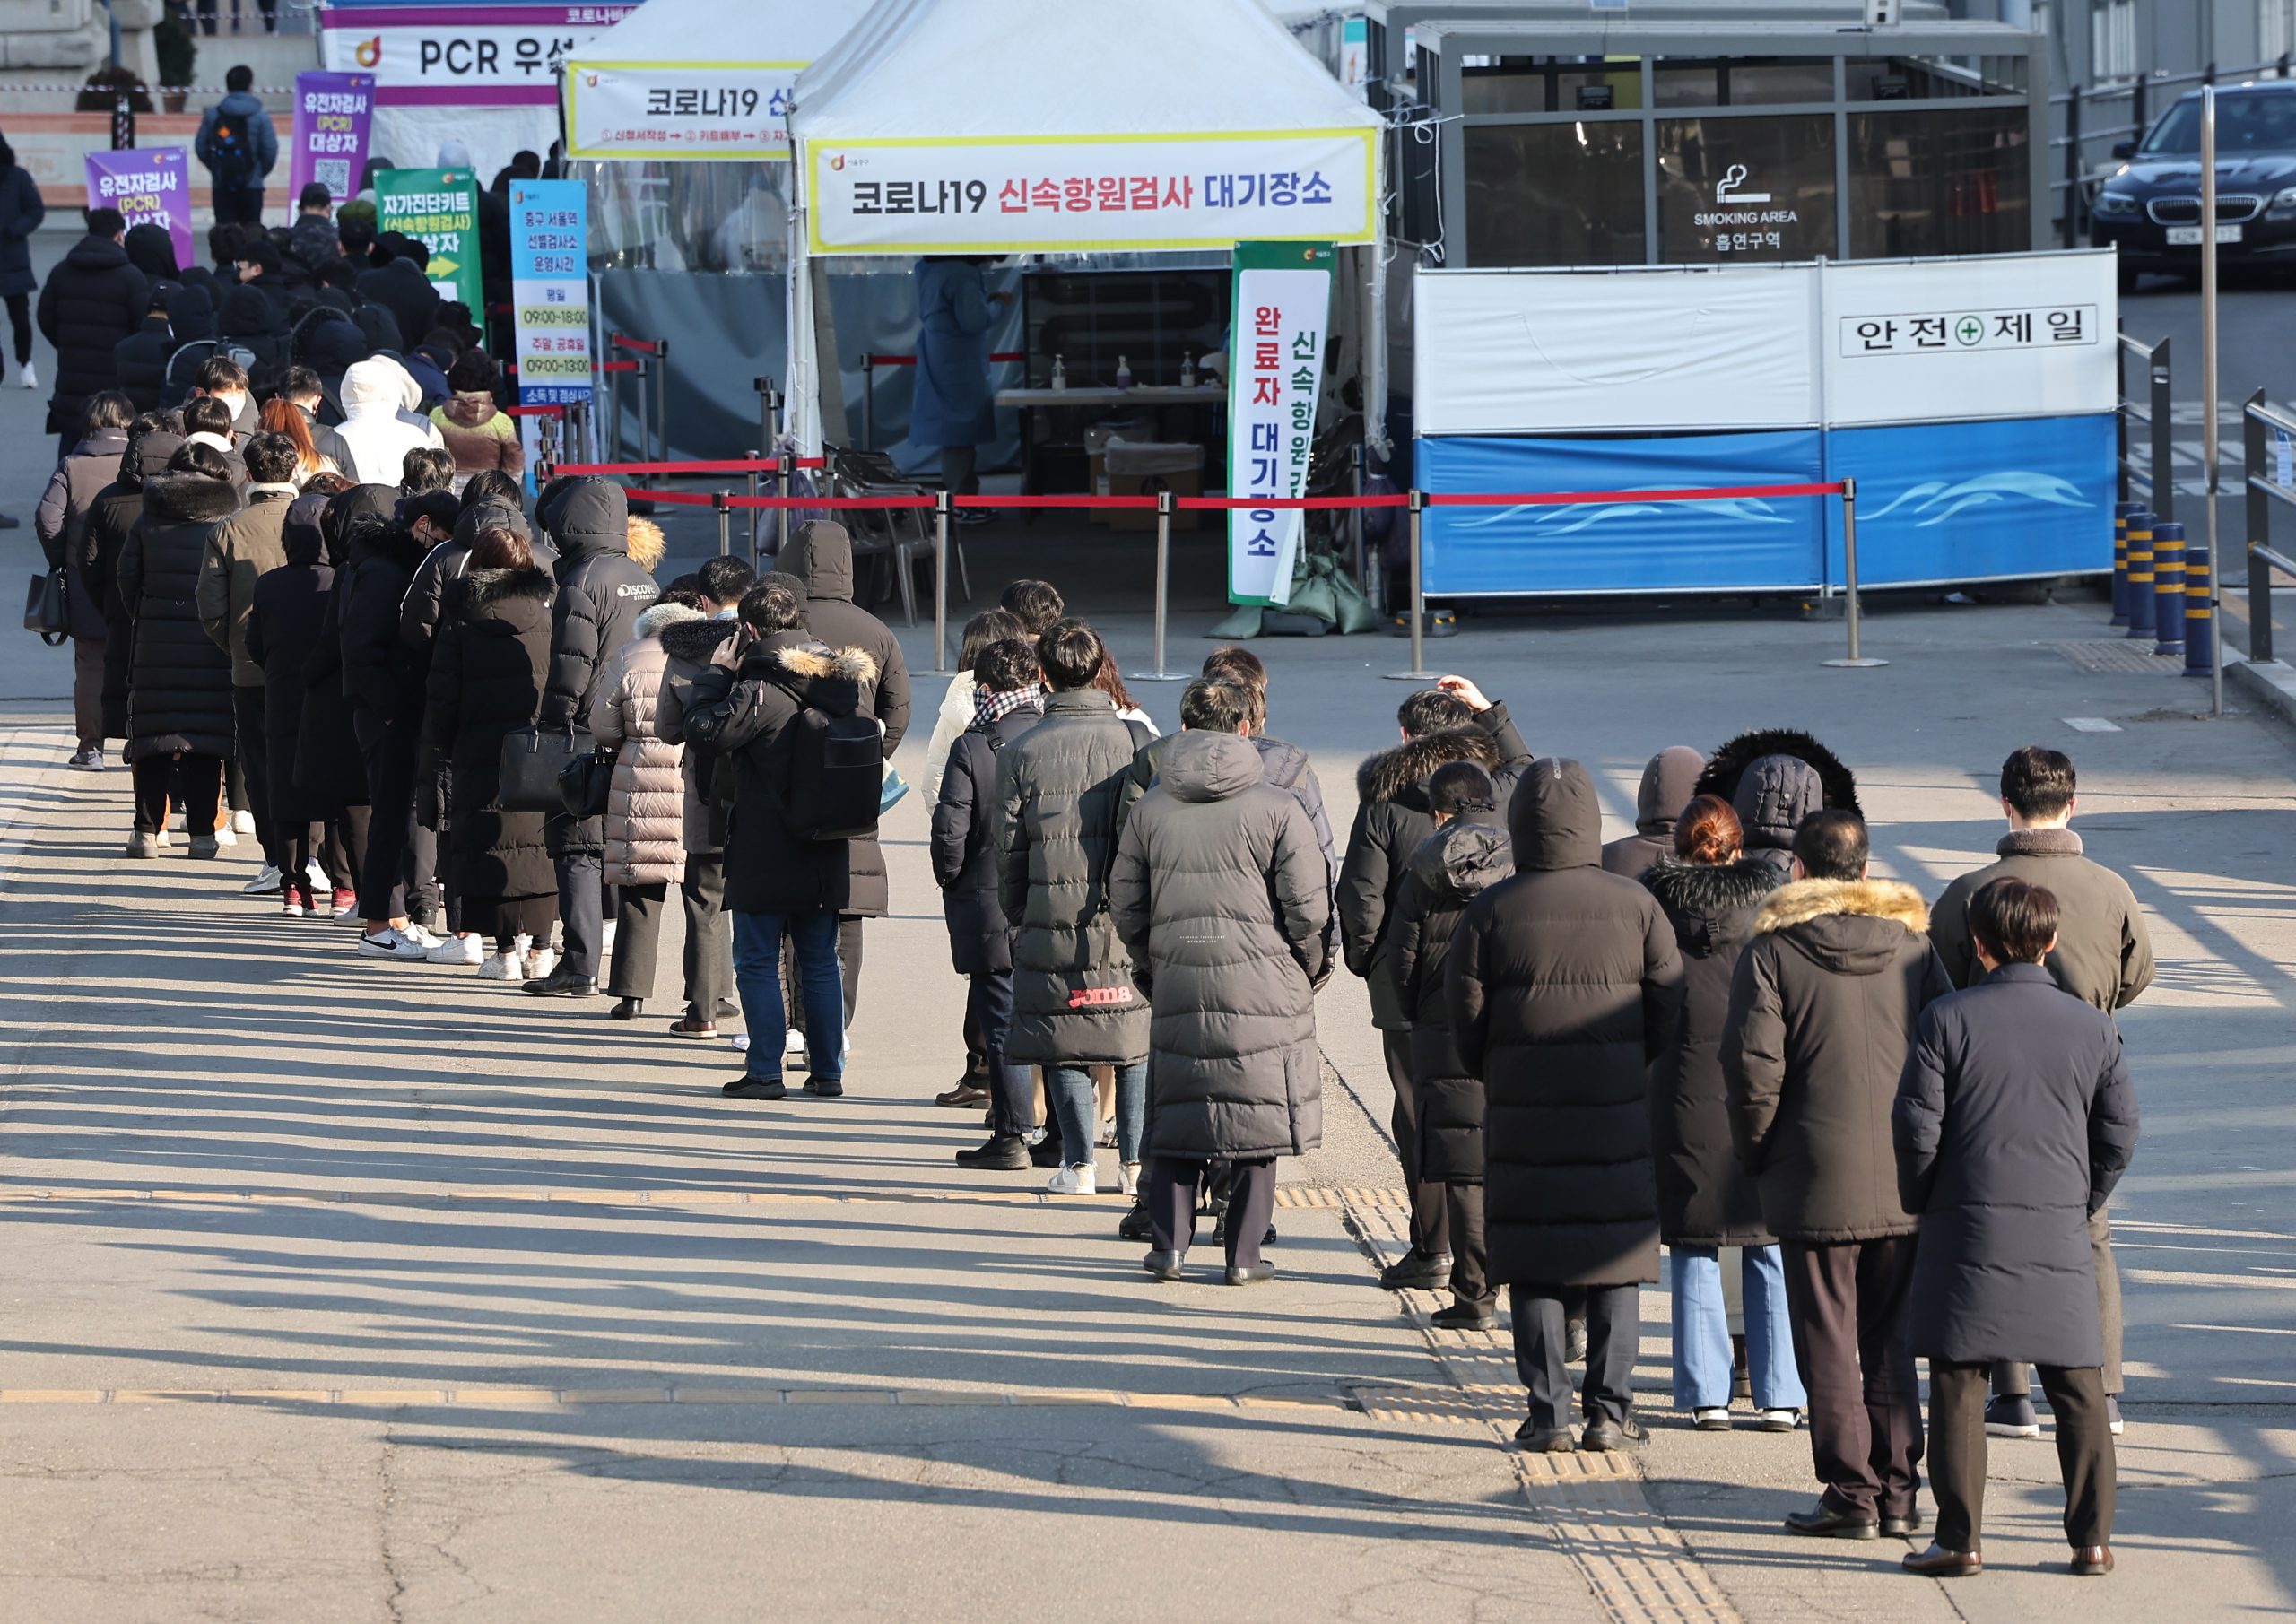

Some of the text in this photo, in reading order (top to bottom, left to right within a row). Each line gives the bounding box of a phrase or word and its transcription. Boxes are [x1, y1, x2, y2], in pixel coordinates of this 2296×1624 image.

[421, 39, 499, 74] PCR
[304, 92, 367, 114] 유전자검사
[646, 88, 759, 117] 코로나19
[317, 116, 352, 132] (PCR)
[309, 133, 359, 153] 대상자
[100, 171, 178, 197] 유전자검사
[852, 171, 1333, 214] 코로나19 신속항원검사 대기장소
[118, 194, 160, 214] (PCR)
[383, 192, 471, 215] 자가진단키트
[385, 214, 472, 232] (신속항원검사)
[525, 212, 578, 227] 중구 서울역
[1694, 211, 1797, 225] SMOKING AREA
[528, 234, 578, 249] 선별검사소
[1716, 231, 1780, 251] 흡연구역
[535, 256, 574, 272] 운영시간
[546, 289, 566, 302] 평일
[557, 337, 585, 351] 공휴일
[1253, 306, 1281, 406] 완료자
